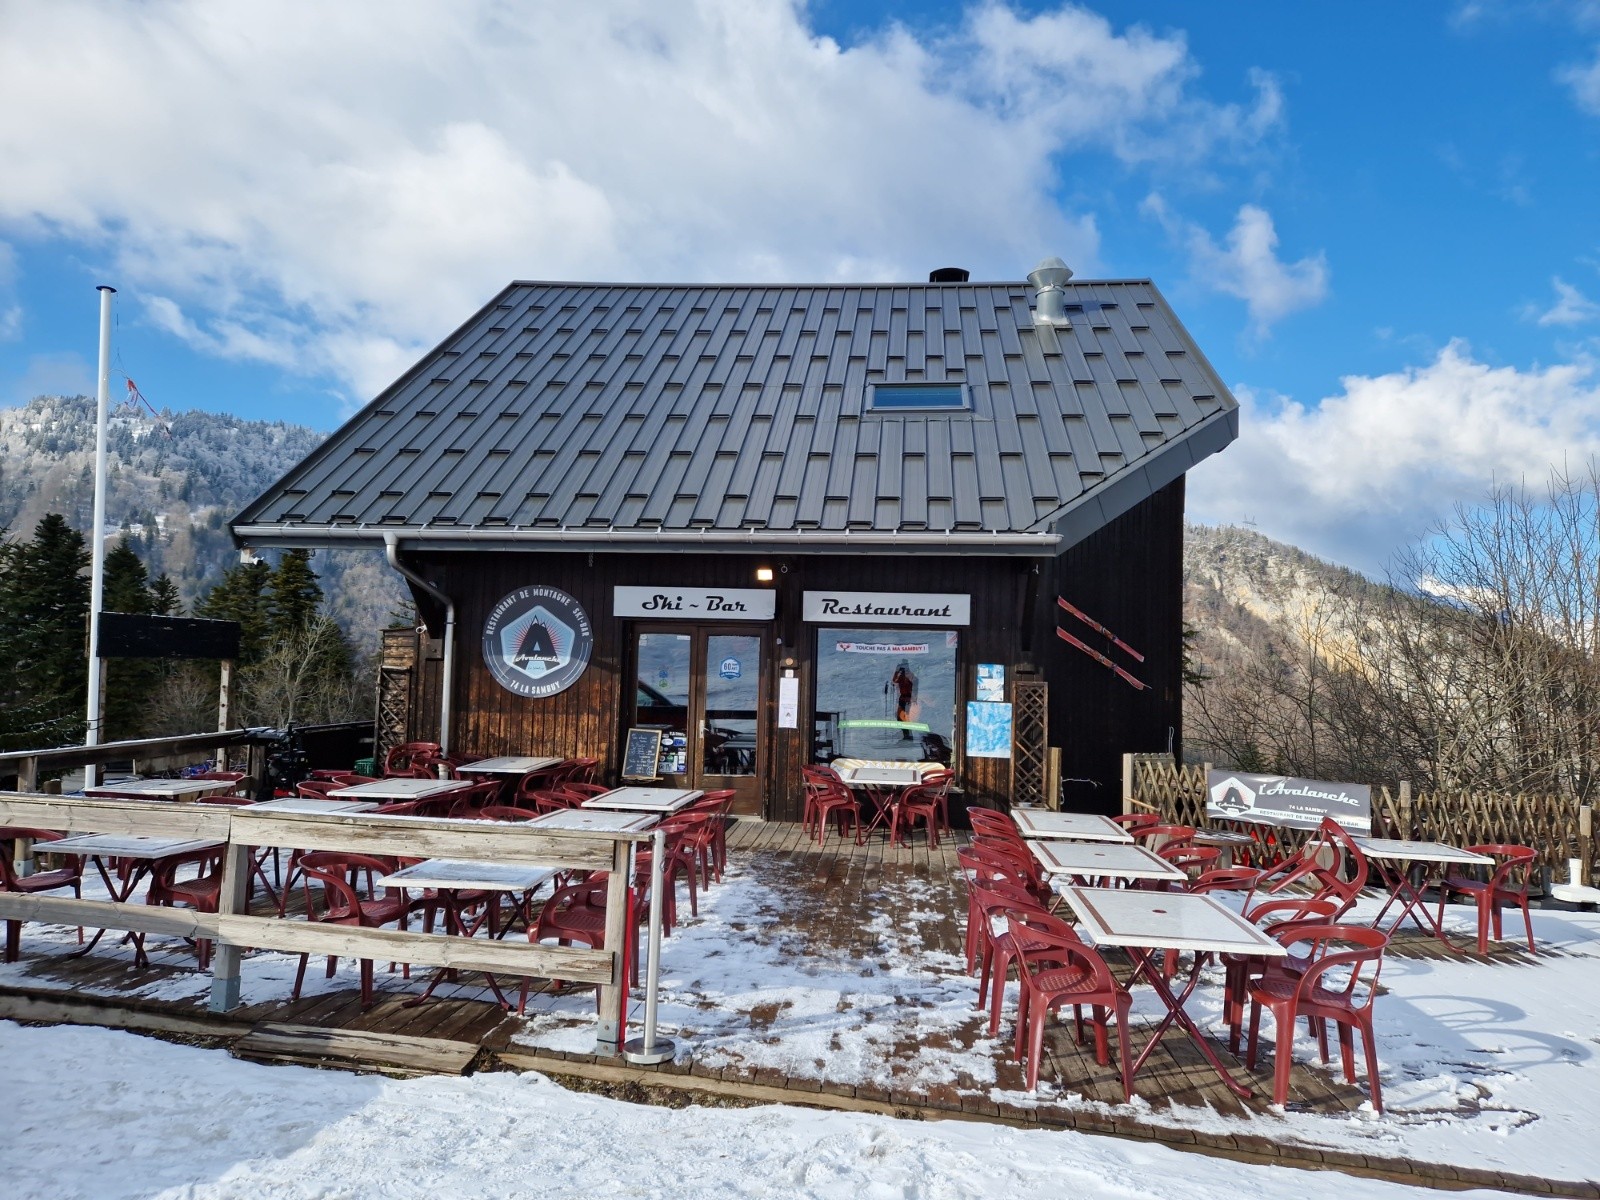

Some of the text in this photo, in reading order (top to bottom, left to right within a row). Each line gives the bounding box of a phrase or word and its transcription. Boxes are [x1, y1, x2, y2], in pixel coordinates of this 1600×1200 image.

[641, 594, 683, 611] Ski
[706, 595, 748, 612] Bar
[821, 598, 952, 617] Restaurant
[486, 588, 590, 637] RESTAURANT DE MONTAGNE SKI-BAR
[510, 679, 561, 694] 74 LA SAMBUY
[1258, 781, 1361, 807] L'Avalanche
[1259, 810, 1294, 819] RESTAURANT
